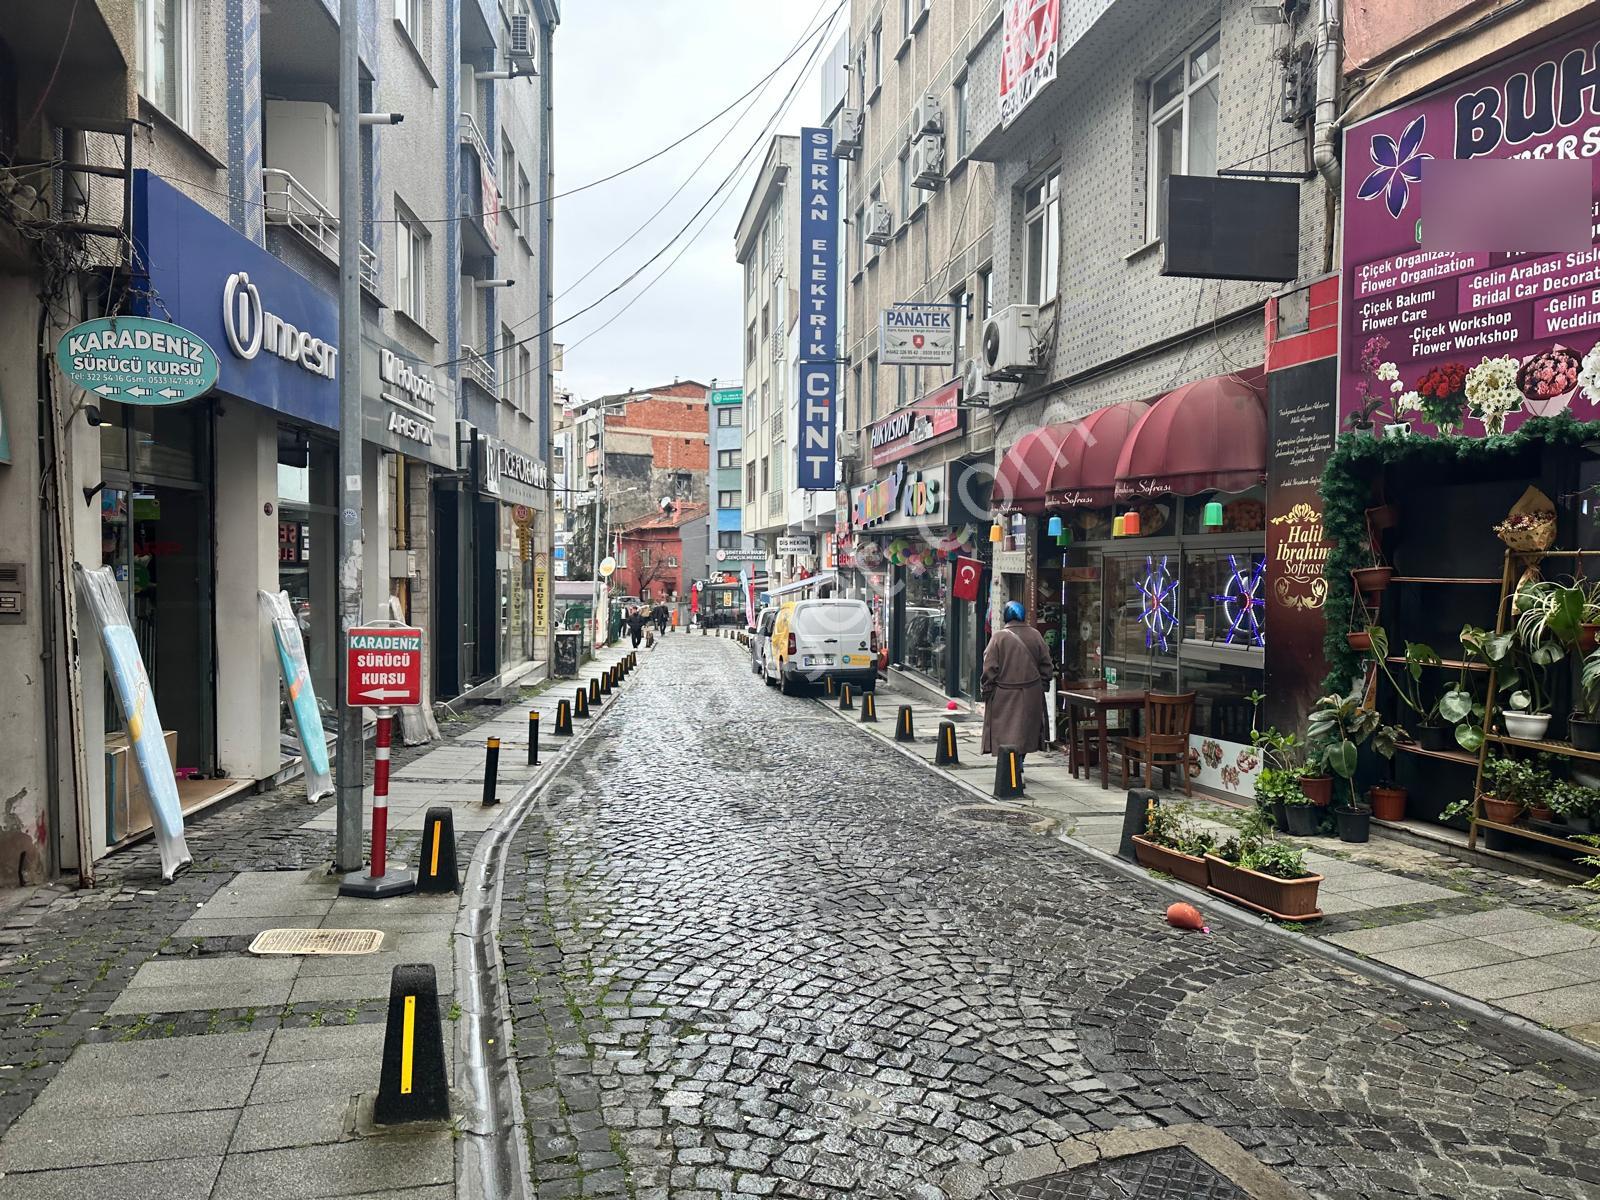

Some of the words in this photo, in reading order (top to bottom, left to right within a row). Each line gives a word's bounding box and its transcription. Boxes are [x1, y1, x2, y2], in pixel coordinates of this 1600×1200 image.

[811, 133, 829, 221] SERKAN
[1358, 261, 1392, 281] -Çiçek
[1361, 277, 1398, 294] Flower
[1400, 256, 1475, 284] Organization
[1468, 271, 1506, 290] -Gelin
[1509, 259, 1561, 282] Arabası
[809, 239, 828, 356] ELEKTRİK
[1359, 298, 1393, 319] -Çiçek
[1396, 290, 1436, 308] Bakımı
[1472, 287, 1511, 308] Bridal
[1515, 283, 1539, 298] Car
[1543, 294, 1586, 314] -Gelin
[887, 312, 951, 327] PANATEK
[1362, 315, 1399, 332] Flower
[1402, 308, 1427, 323] Care
[1409, 322, 1446, 343] -Çiçek
[1448, 311, 1512, 334] Workshop
[69, 329, 204, 363] KARADENİZ
[1412, 340, 1452, 357] Flower
[1454, 328, 1519, 349] Workshop
[73, 354, 142, 373] SÜRÜCÜ
[147, 361, 201, 376] KURSU
[70, 372, 85, 380] Tel:
[126, 375, 147, 383] Gsm:
[388, 412, 434, 446] ARISTON
[871, 411, 914, 449] HIKVISION
[1136, 478, 1171, 495] Sofrası
[1061, 491, 1093, 507] Sofrası
[1288, 525, 1324, 543] Halil
[1284, 560, 1324, 577] Sofrası
[350, 636, 420, 650] KARADENİZ
[357, 652, 411, 667] SÜRÜCÜ
[361, 672, 406, 685] KURSU
